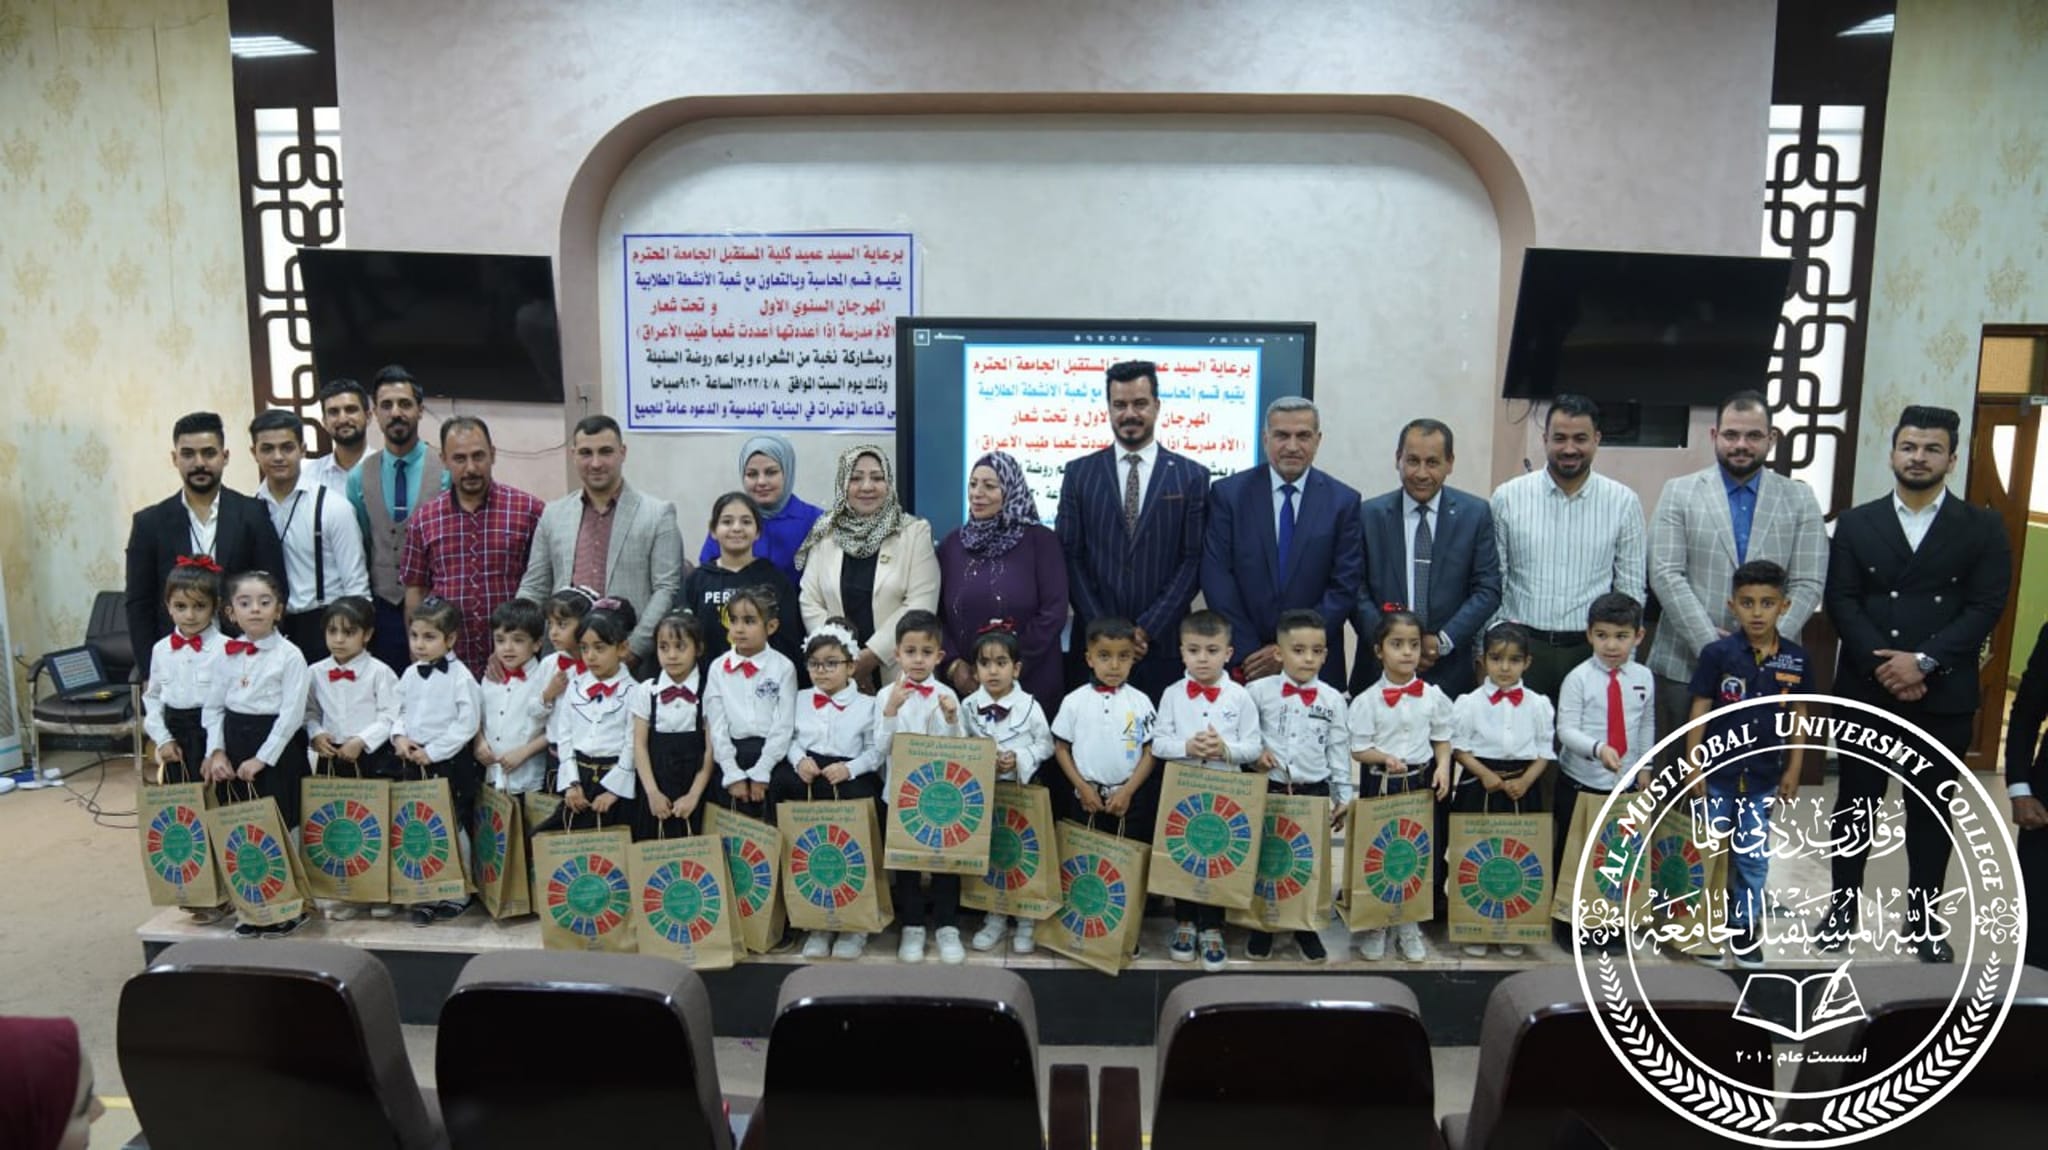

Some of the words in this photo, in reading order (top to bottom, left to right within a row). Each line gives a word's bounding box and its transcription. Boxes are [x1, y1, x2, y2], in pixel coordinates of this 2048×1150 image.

[632, 246, 670, 264] المحترم
[673, 246, 716, 264] الجامعة
[719, 246, 764, 264] المستقبل
[768, 245, 791, 264] كلية
[795, 247, 823, 264] عميد
[827, 246, 860, 264] السيد
[863, 246, 903, 264] برعاية
[635, 272, 675, 290] الطلابية
[718, 272, 742, 290] شعبة
[743, 276, 756, 291] مع
[808, 272, 847, 291] المحاسبة
[850, 272, 872, 290] قسم
[874, 272, 902, 291] يقيم
[649, 297, 678, 316] شعار
[680, 297, 705, 312] تحت
[710, 303, 718, 316] و
[792, 299, 834, 317] السنوي
[836, 299, 886, 316] المهرجان
[685, 349, 713, 367] روضة
[756, 348, 794, 367] الشعراء
[796, 351, 810, 367] من
[812, 349, 838, 368] نخبة
[842, 349, 892, 368] وبمشاركة
[974, 356, 1013, 374] المحترم
[1016, 356, 1060, 375] الجامعة
[1173, 360, 1206, 376] السيد
[1210, 359, 1251, 377] برعاية
[788, 375, 815, 393] الموافق
[817, 376, 845, 394] السبت
[847, 379, 863, 393] يوم
[864, 375, 888, 393] وذلك
[1063, 382, 1088, 402] شعبة
[1090, 389, 1103, 402] مع
[666, 400, 687, 414] عامة
[771, 401, 802, 419] البناية
[804, 402, 816, 421] في
[861, 402, 885, 415] قاعة
[1010, 407, 1039, 425] شعار
[1042, 408, 1068, 423] تحت
[1161, 411, 1211, 429] المهرجان
